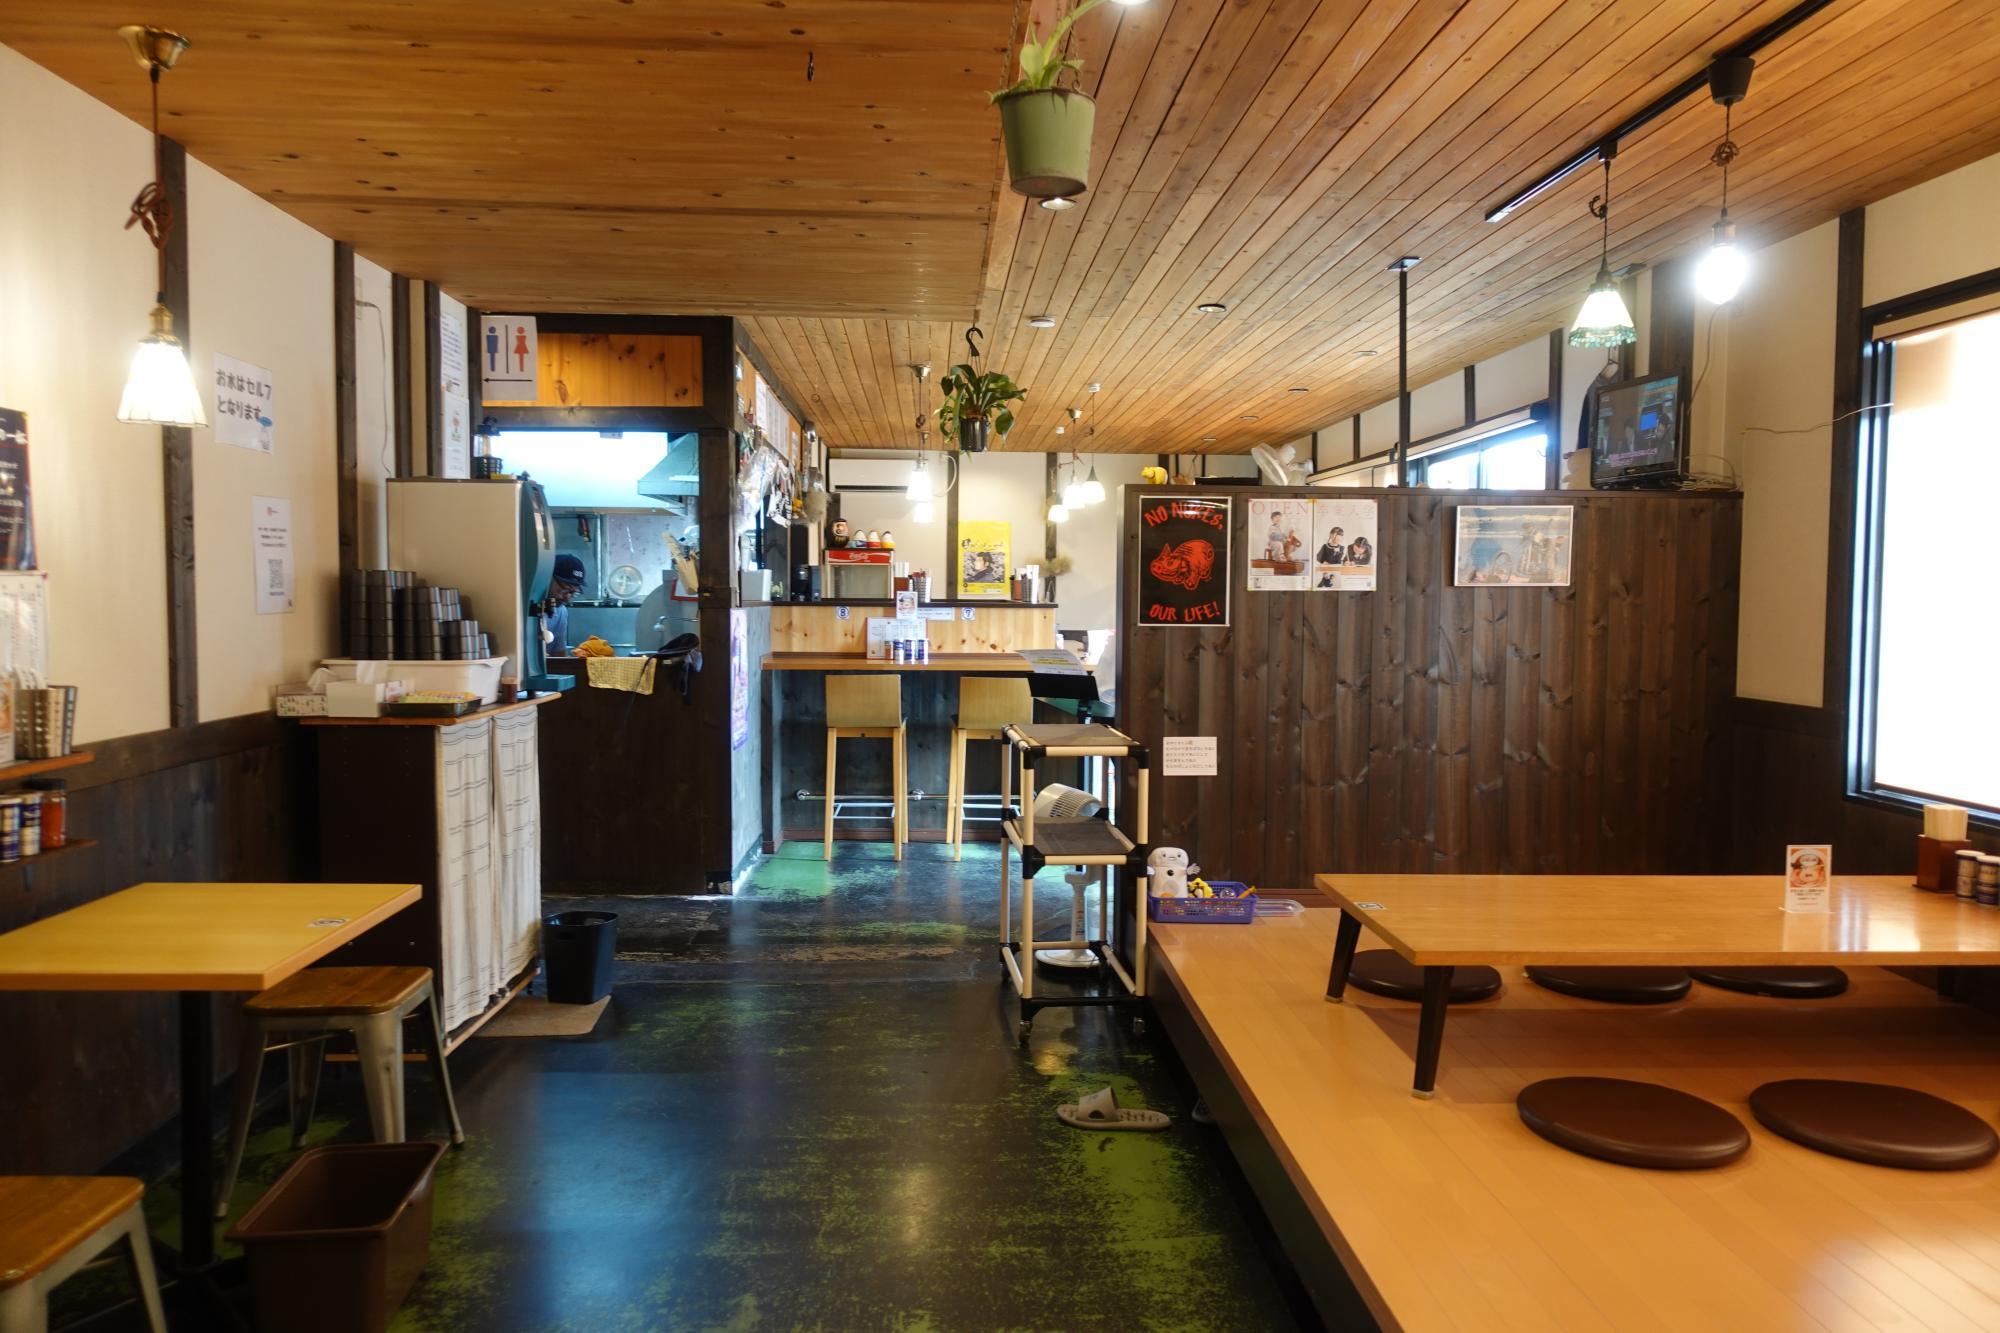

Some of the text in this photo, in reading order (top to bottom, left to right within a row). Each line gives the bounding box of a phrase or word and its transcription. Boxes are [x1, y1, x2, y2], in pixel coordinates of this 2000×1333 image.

[216, 368, 272, 400] お水はセルフ
[217, 394, 262, 422] となります
[1144, 505, 1169, 528] NO
[1251, 501, 1309, 515] OPEN
[1149, 600, 1221, 622] OUR LIFE!
